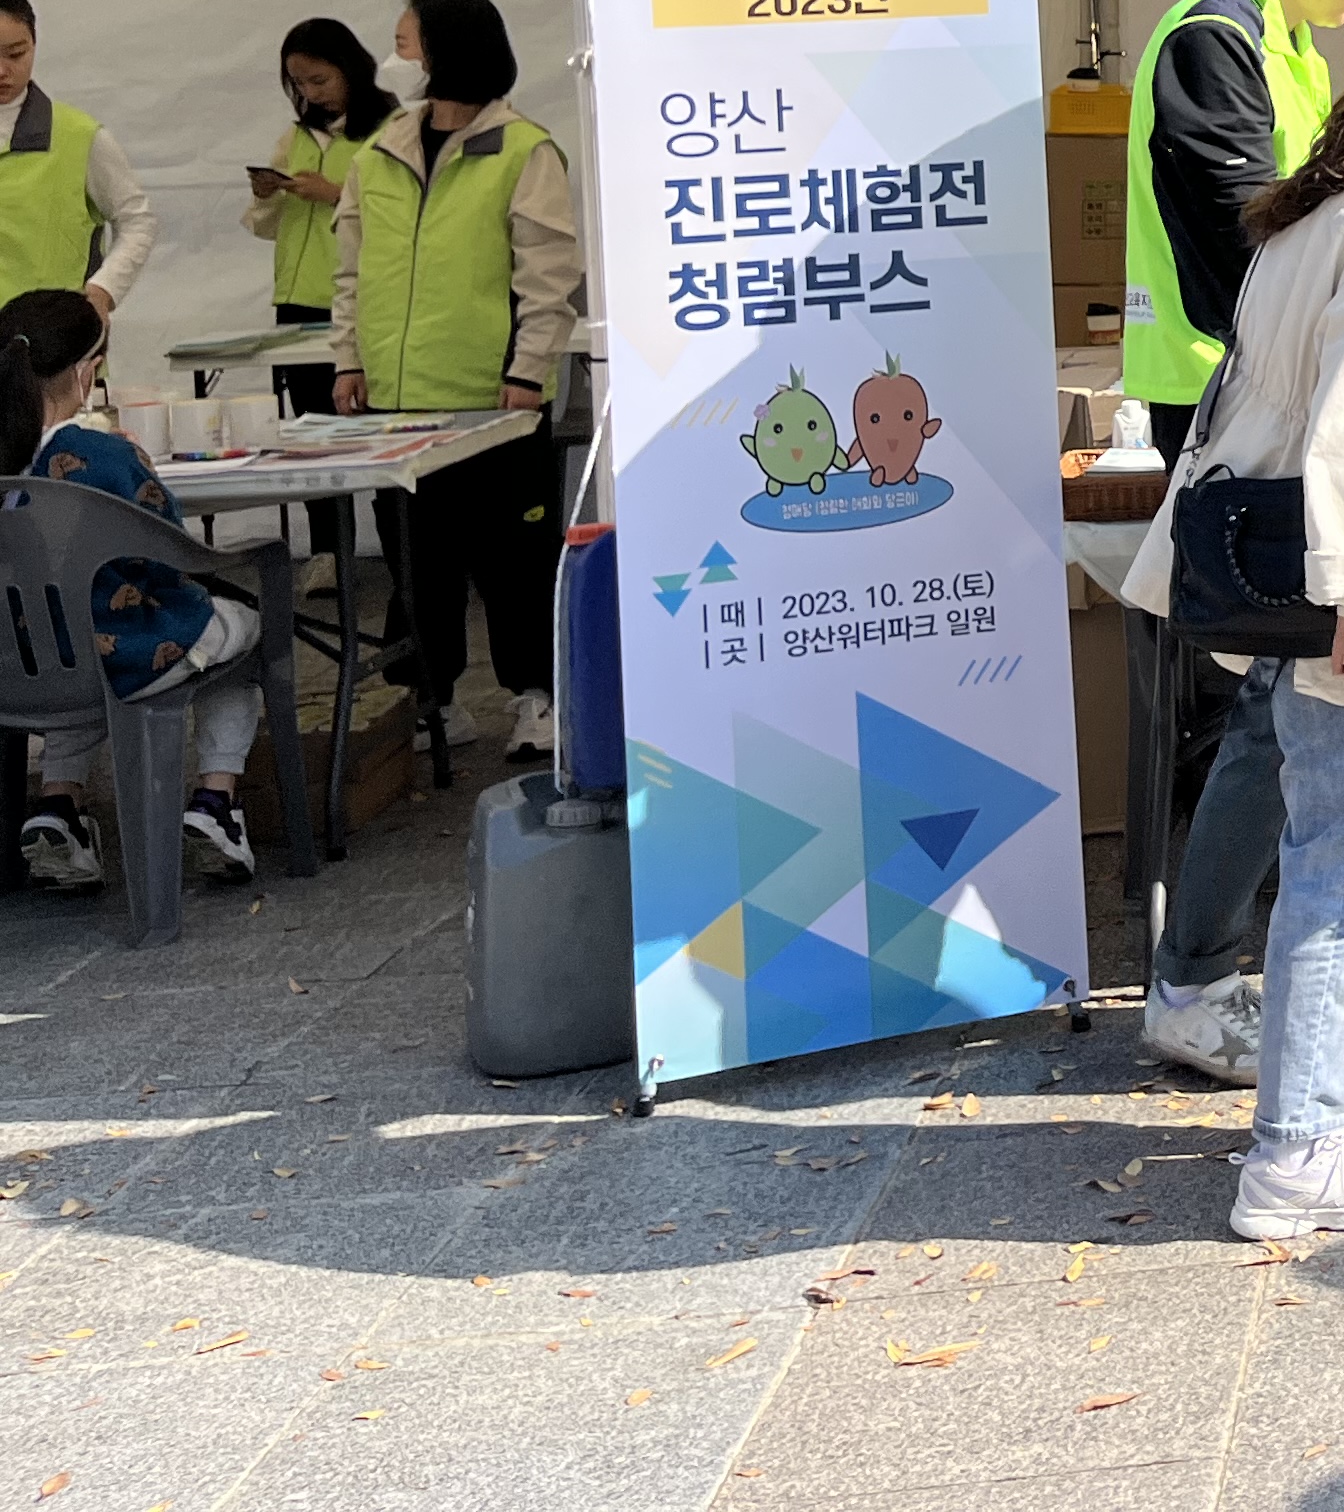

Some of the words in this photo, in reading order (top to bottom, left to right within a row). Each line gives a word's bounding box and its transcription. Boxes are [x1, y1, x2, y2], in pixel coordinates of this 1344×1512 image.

[660, 88, 794, 159] 양산
[663, 159, 990, 247] 진로체험전
[668, 249, 932, 332] 청렴부스
[782, 589, 855, 620] 2023.
[866, 583, 903, 609] 10.
[783, 613, 939, 658] 양산워터파크
[946, 605, 997, 638] 일원
